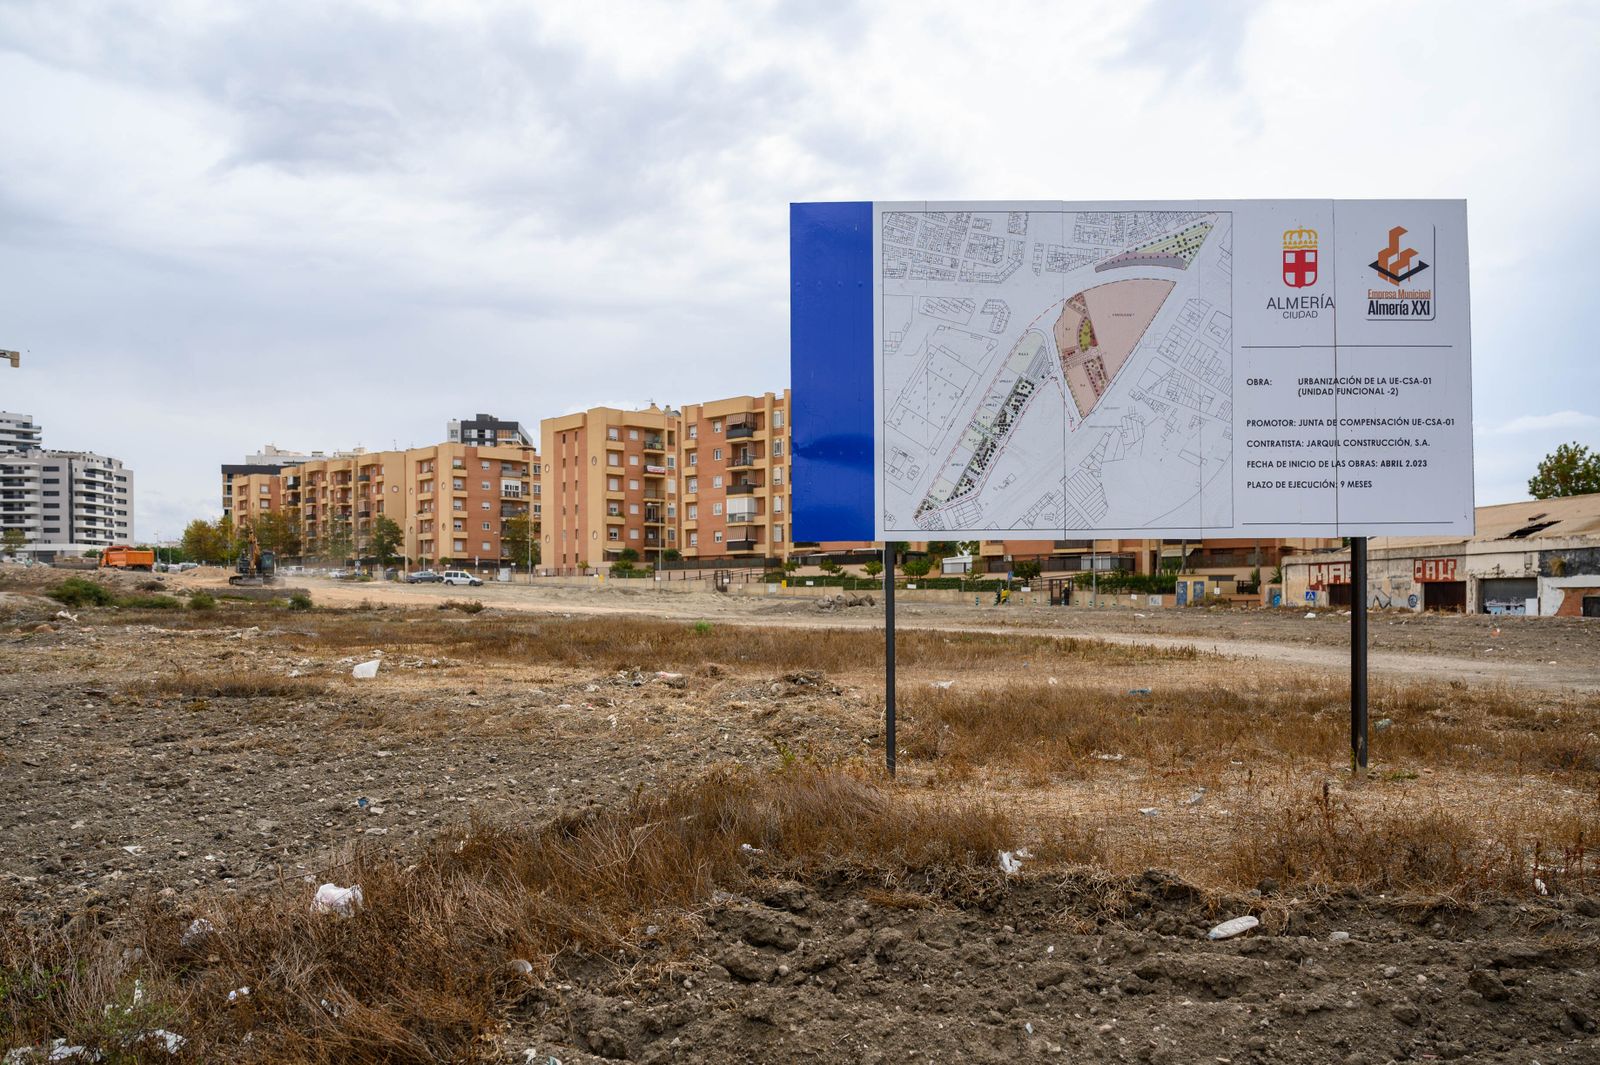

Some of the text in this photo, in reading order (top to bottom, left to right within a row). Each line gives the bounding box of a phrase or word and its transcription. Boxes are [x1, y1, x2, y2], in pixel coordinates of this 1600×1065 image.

[1368, 289, 1431, 299] Empresa Municipal
[1266, 294, 1335, 310] ALMERÍA
[1368, 300, 1430, 316] Almería XXI
[1282, 310, 1318, 319] CIUDAD
[1298, 375, 1362, 385] URBANIZACIÓN
[1298, 388, 1399, 398] (UNIDAD FUNCIONAL -2)
[1246, 420, 1296, 428] PROMOTOR:
[1298, 419, 1324, 427] JUNTA
[1340, 416, 1410, 426] COMPENSACIÓN
[1246, 440, 1304, 448] CONTRATISTA:
[1306, 440, 1340, 448] JARQUIL
[1343, 437, 1412, 447] CONSTRUCCIÓN,
[1288, 478, 1338, 488] EJECUCIÓN:
